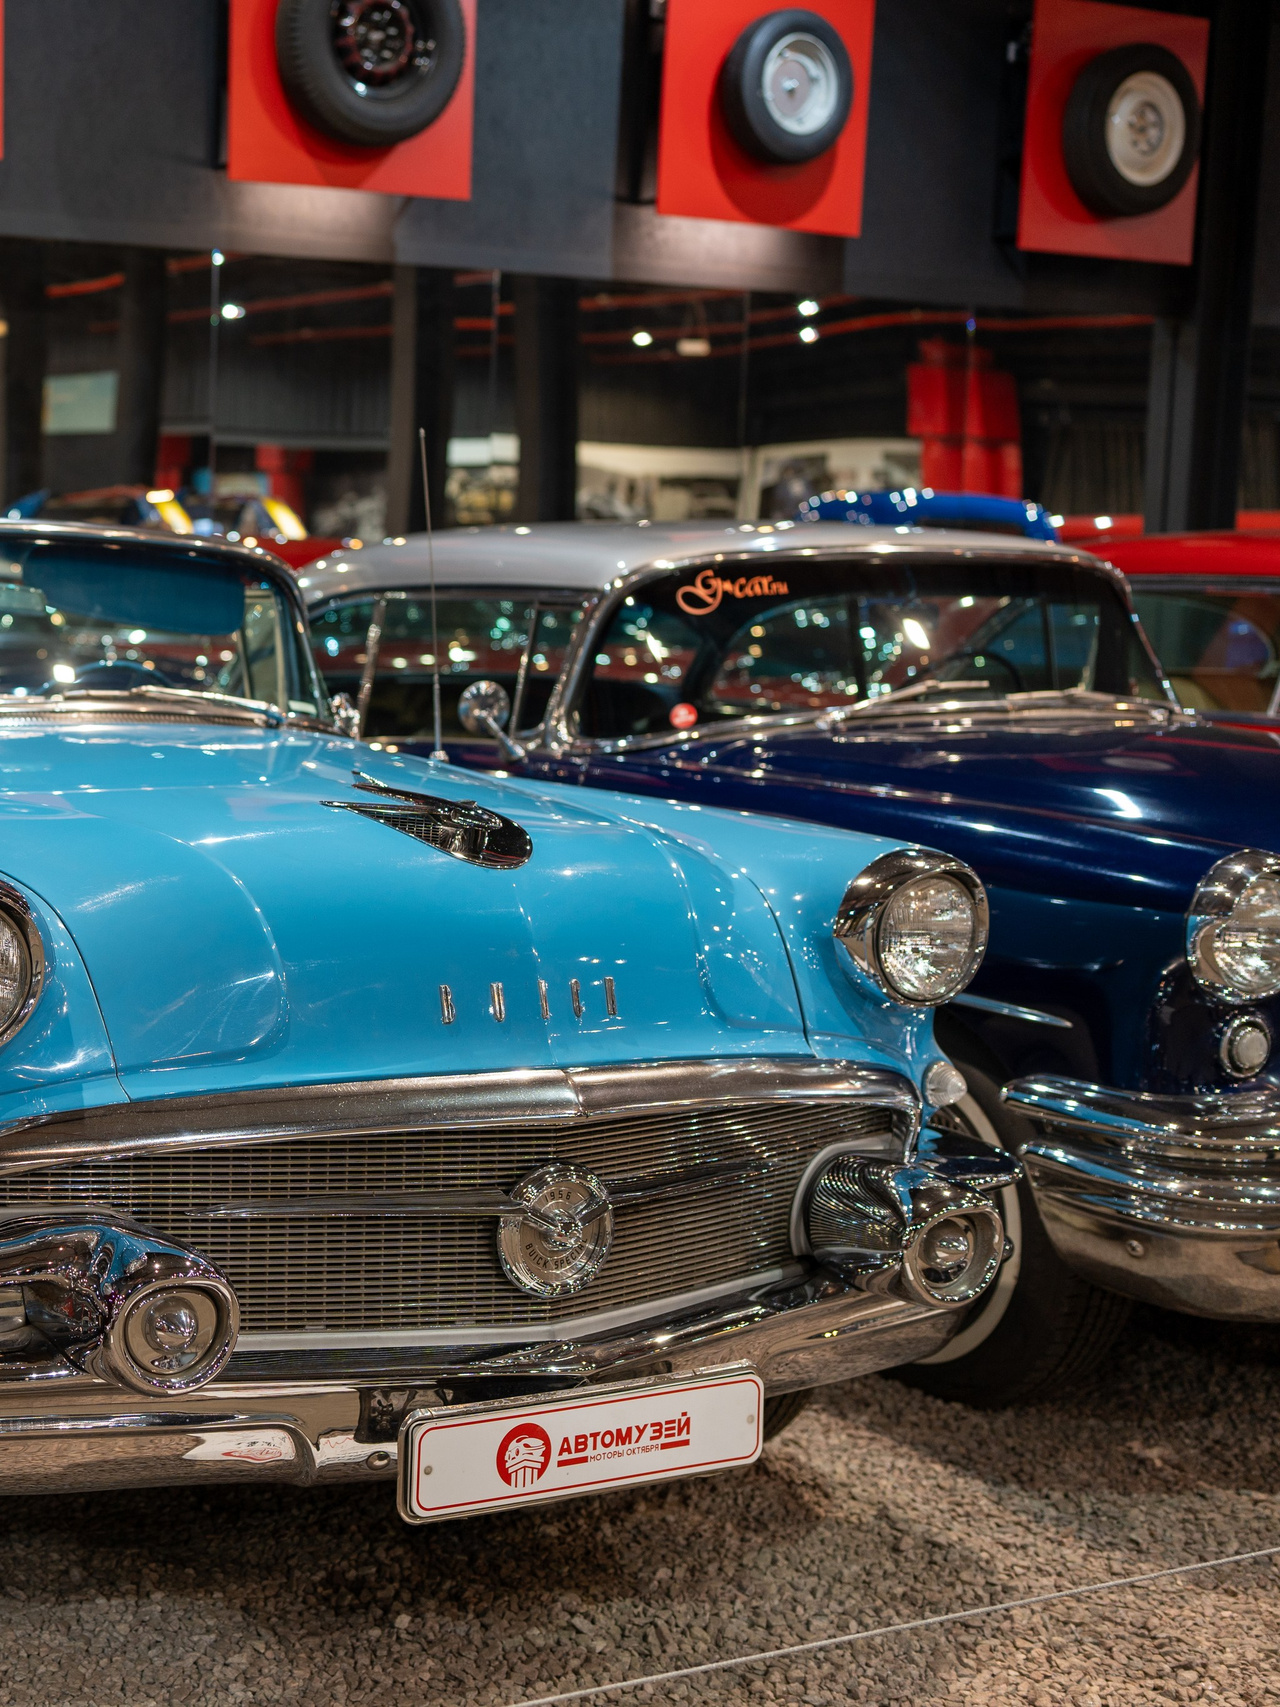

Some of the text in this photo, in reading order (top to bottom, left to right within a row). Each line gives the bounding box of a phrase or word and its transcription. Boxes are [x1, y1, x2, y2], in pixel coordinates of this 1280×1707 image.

[545, 1190, 572, 1203] 1956
[525, 1238, 588, 1270] BUICK SPECIAL
[558, 1411, 691, 1457] АВТОМУЗЕЙ
[589, 1443, 660, 1463] МОТОРЫ ОКТЯБРЯ
